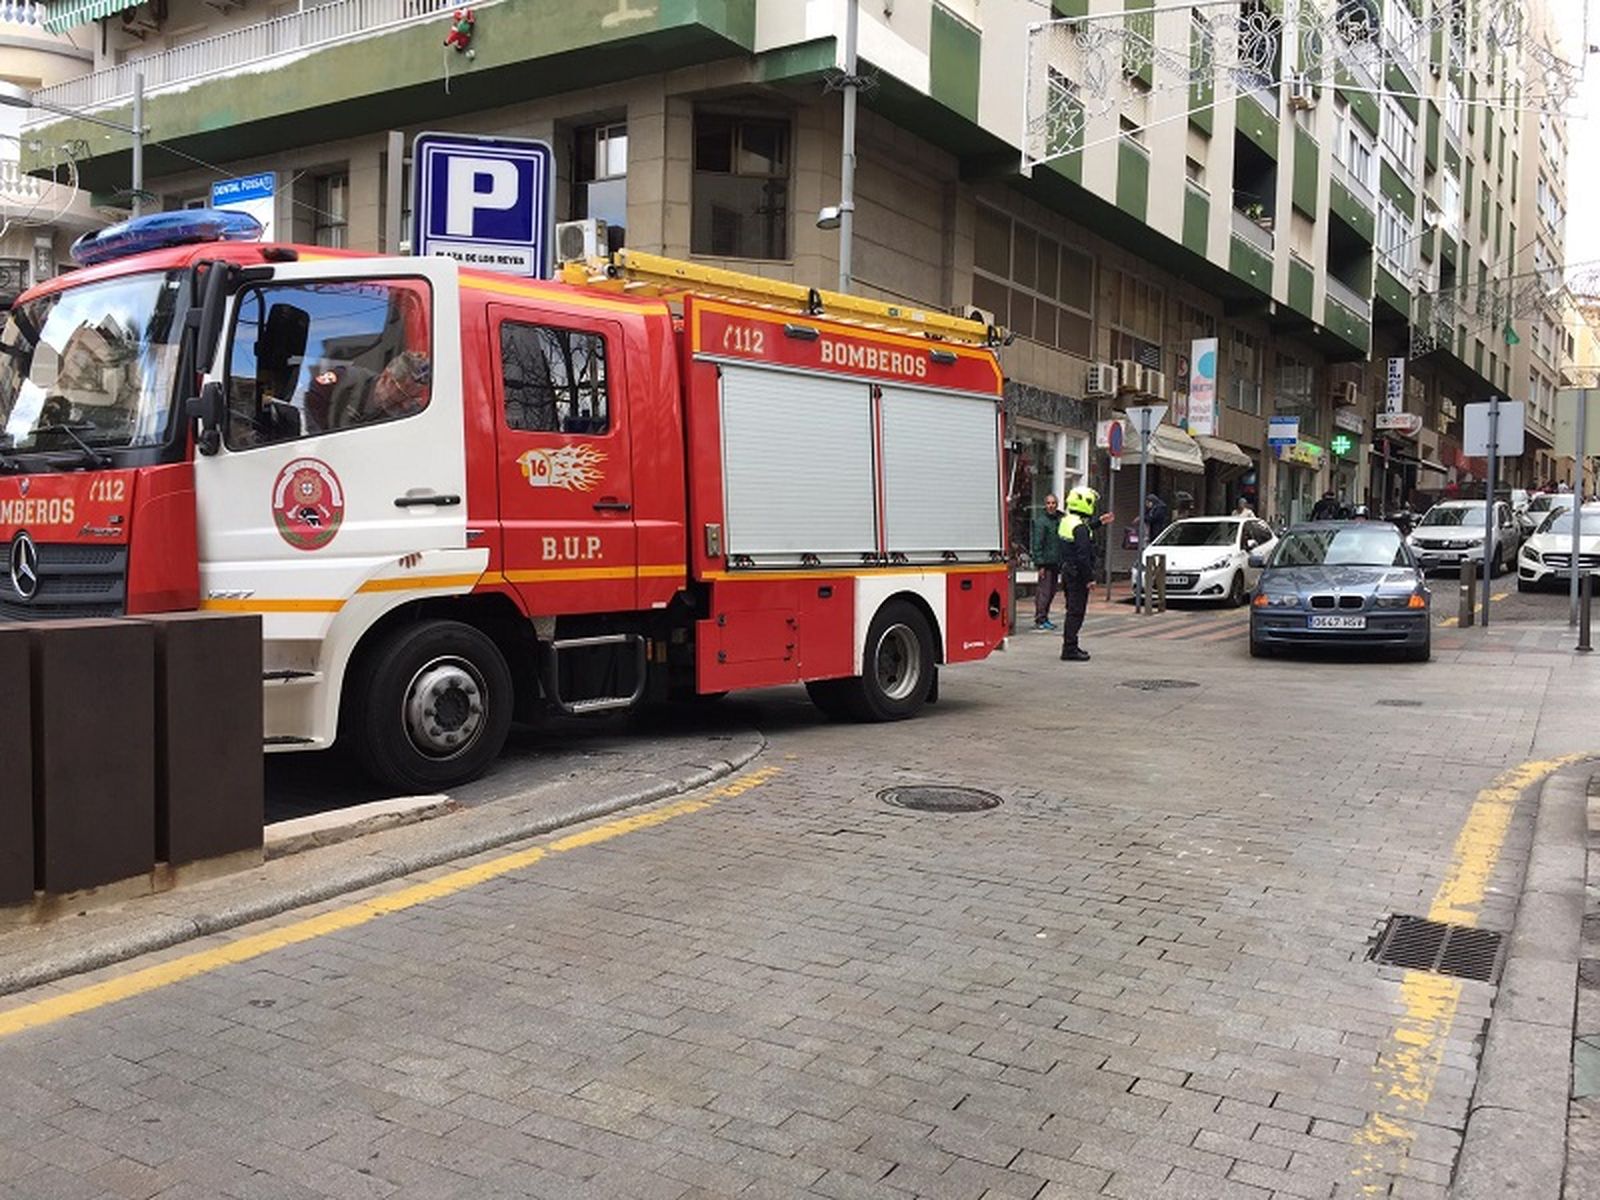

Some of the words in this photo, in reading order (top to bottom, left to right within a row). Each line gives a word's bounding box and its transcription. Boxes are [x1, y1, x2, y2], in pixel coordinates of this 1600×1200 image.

[446, 156, 519, 236] P
[465, 253, 477, 262] DE
[479, 254, 496, 264] LOS
[498, 255, 525, 265] REYES
[738, 327, 764, 353] 112
[820, 340, 927, 378] BOMBEROS
[530, 459, 547, 477] 16
[98, 479, 125, 501] 112
[541, 536, 603, 560] B.U.P.
